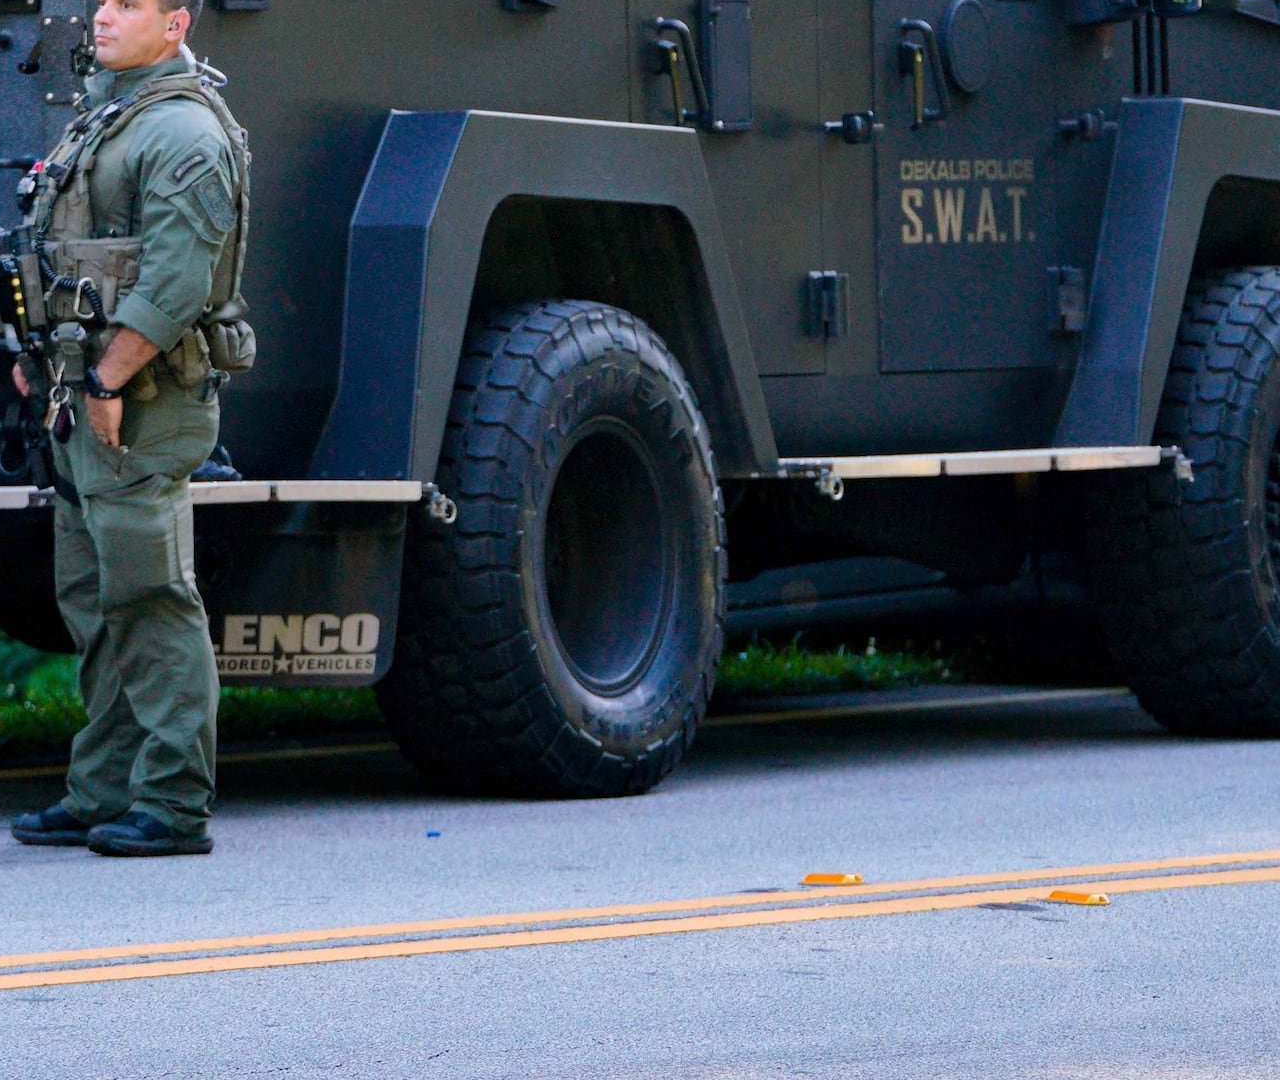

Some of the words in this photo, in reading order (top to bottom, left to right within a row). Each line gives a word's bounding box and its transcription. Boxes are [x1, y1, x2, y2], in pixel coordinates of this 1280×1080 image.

[901, 160, 971, 180] DEKALB
[974, 160, 1035, 180] POLICE
[901, 187, 1036, 244] S.W.A.T.
[208, 613, 380, 655] ENCO
[215, 658, 271, 671] MORED
[295, 655, 375, 670] VEHICLES
